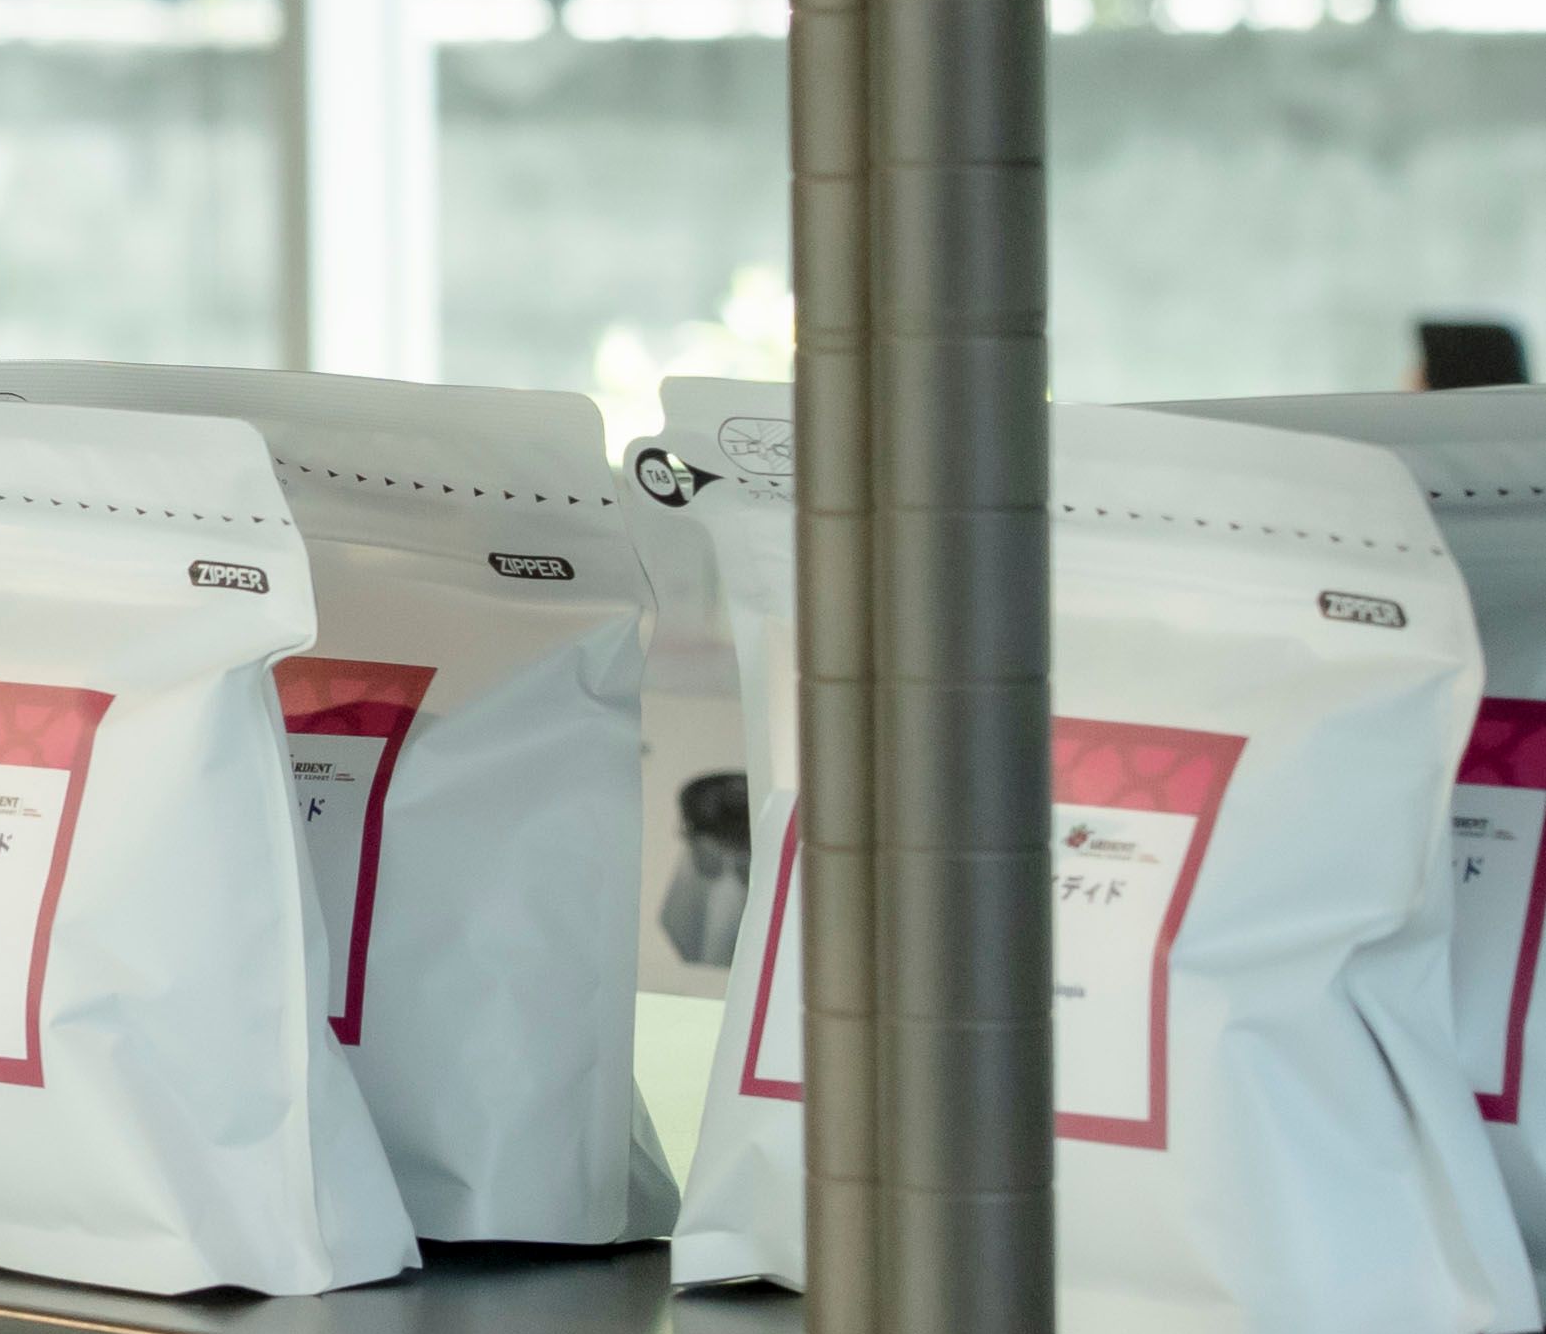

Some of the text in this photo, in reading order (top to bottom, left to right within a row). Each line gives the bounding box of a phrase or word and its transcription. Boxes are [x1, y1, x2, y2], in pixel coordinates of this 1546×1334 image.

[197, 563, 265, 592] ZIPPER
[495, 554, 568, 580] ZIPPER
[1322, 595, 1403, 626] ZIPPER
[293, 760, 333, 775] RDENT
